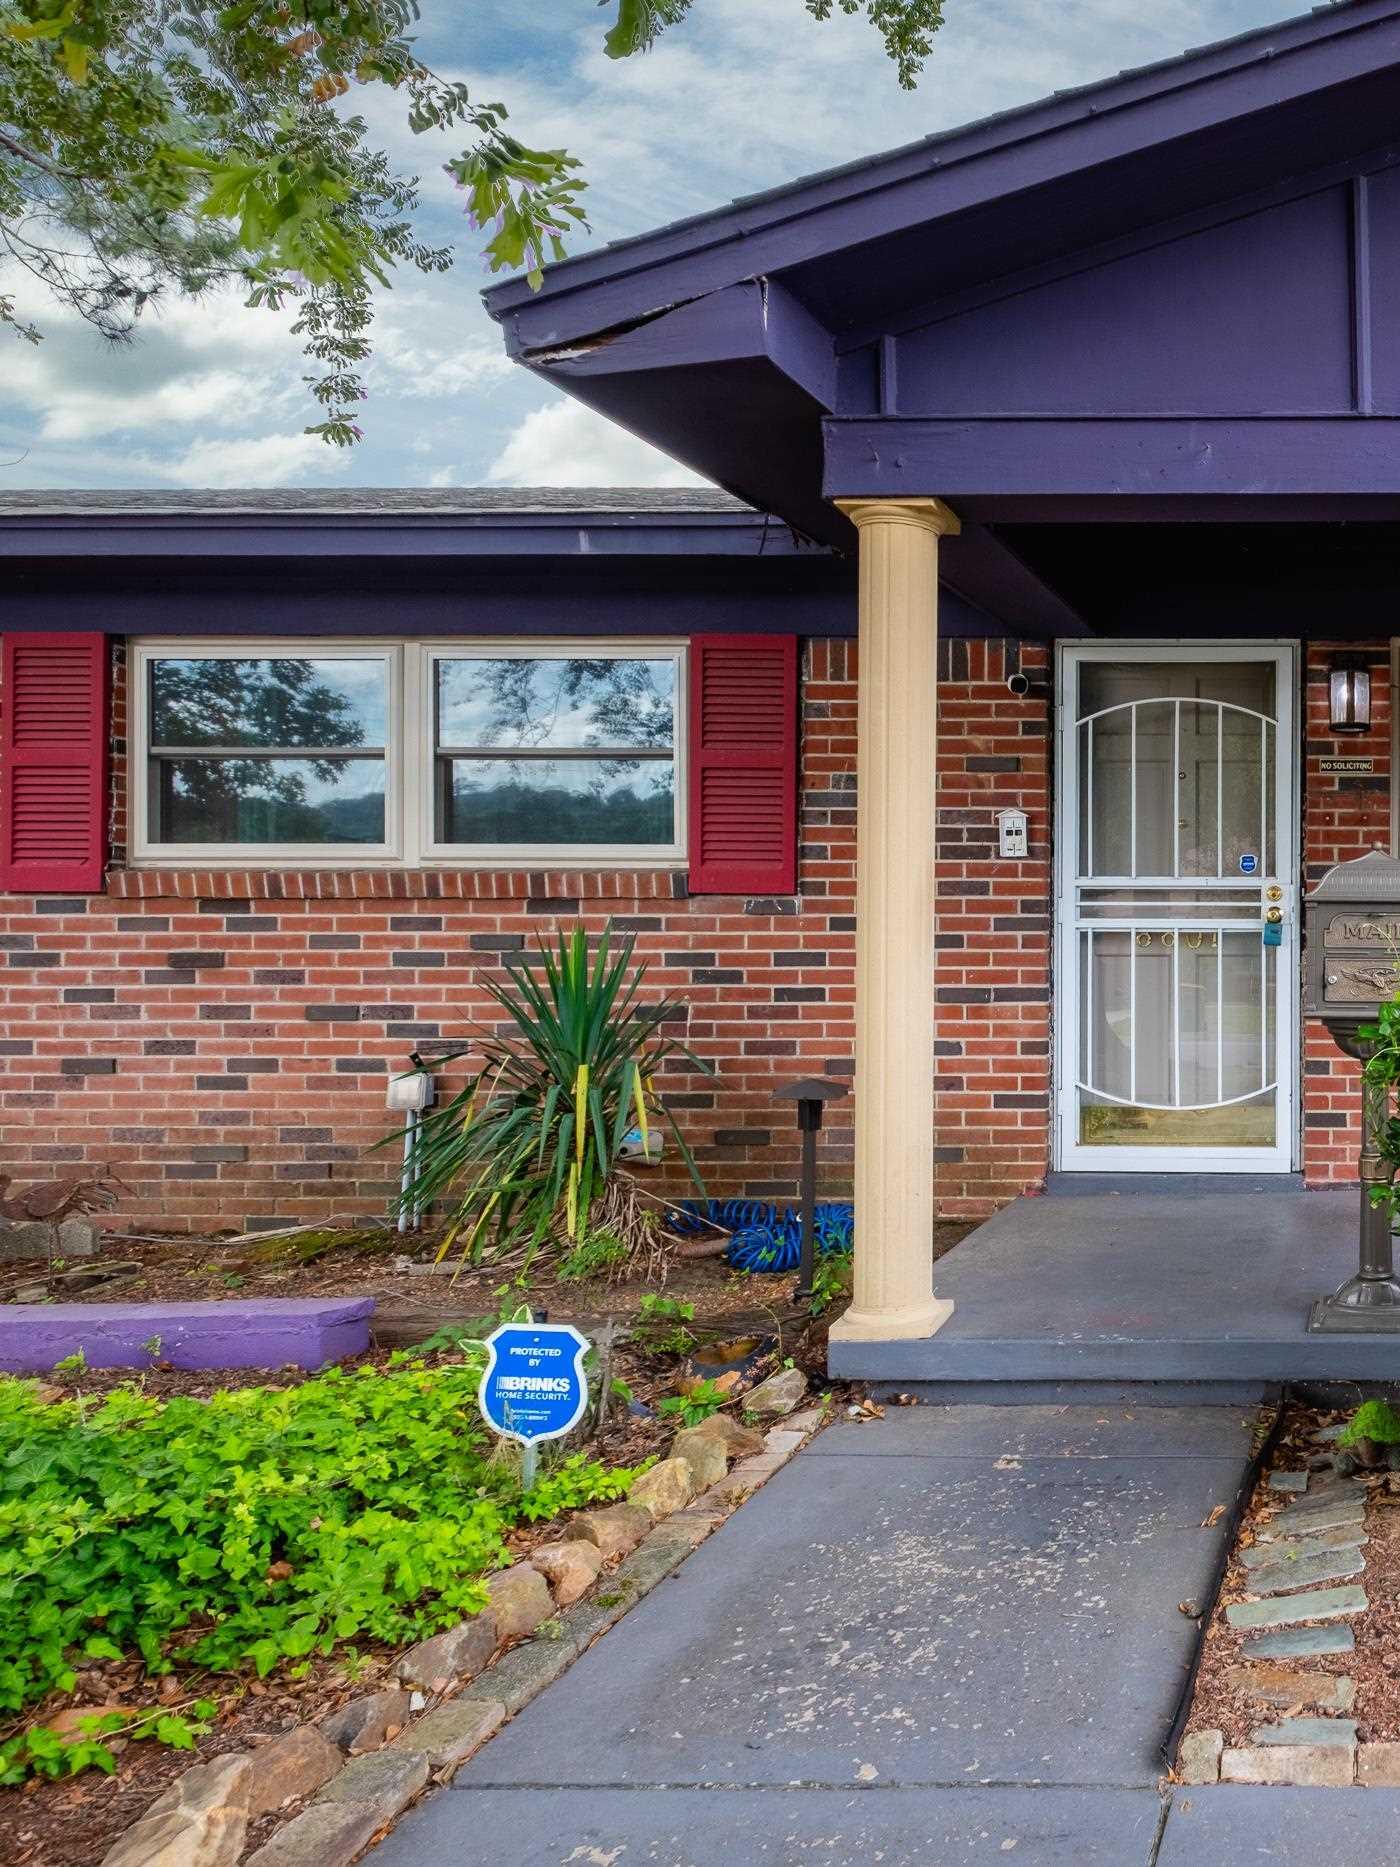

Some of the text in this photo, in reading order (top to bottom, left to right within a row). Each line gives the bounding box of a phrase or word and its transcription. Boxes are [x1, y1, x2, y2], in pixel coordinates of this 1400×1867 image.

[1321, 762, 1372, 770] NO SOLICITING
[510, 1347, 562, 1356] PROTECTED
[528, 1358, 541, 1367] BY
[505, 1376, 570, 1392] BRINKS
[496, 1391, 569, 1401] HOME SECURITY
